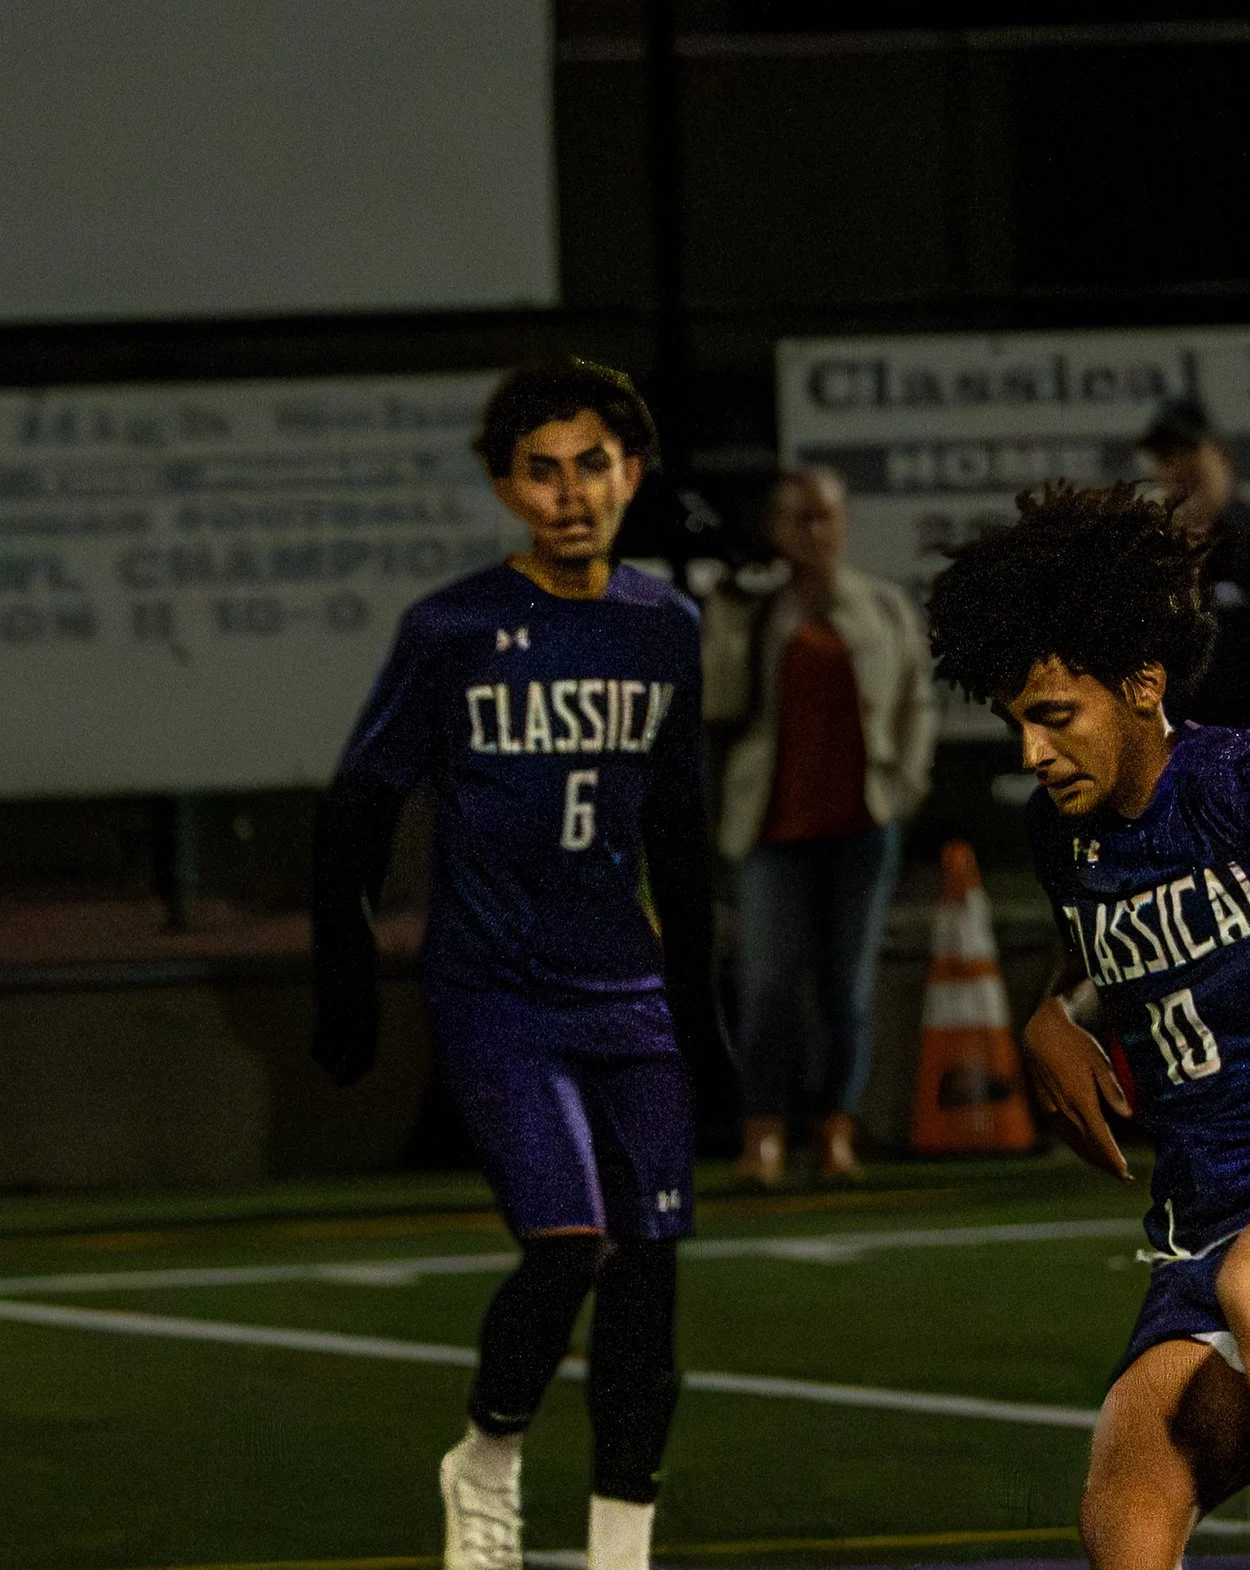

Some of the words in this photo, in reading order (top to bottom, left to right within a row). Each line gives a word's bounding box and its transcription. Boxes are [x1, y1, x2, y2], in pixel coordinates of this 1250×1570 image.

[806, 349, 1197, 409] Classical
[885, 444, 1101, 486] HOME
[560, 767, 601, 851] 6
[1144, 987, 1223, 1087] 10
